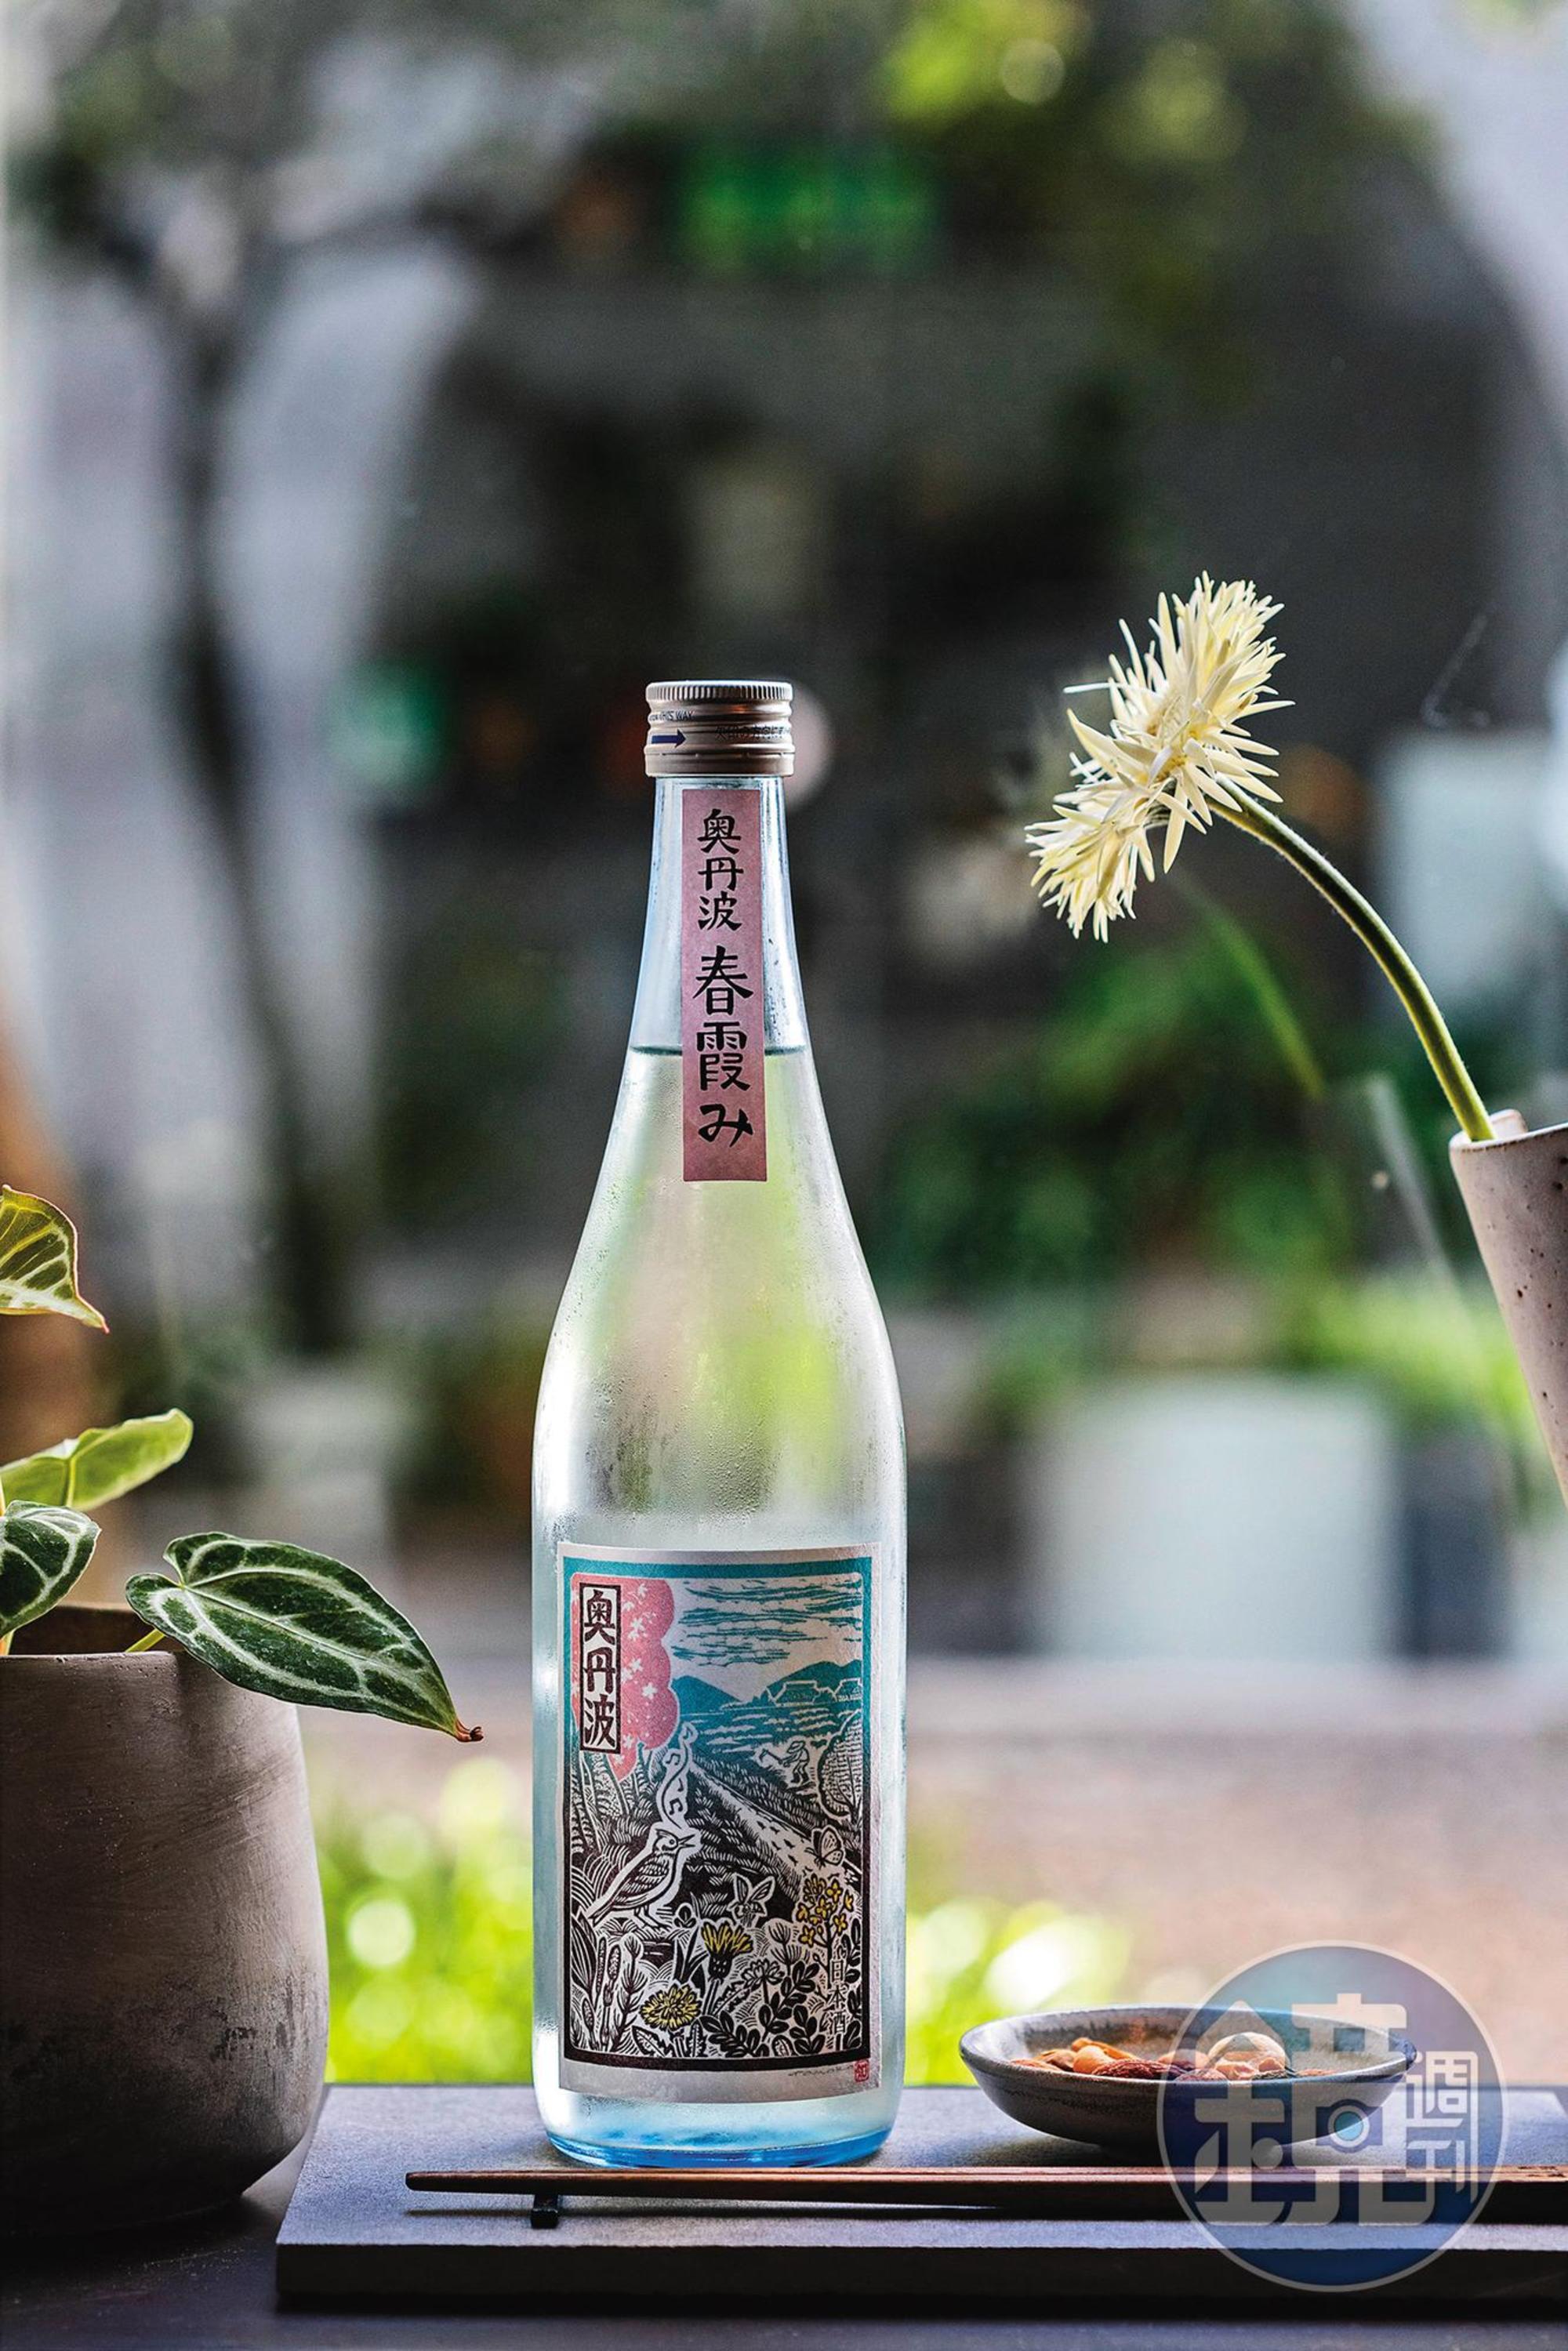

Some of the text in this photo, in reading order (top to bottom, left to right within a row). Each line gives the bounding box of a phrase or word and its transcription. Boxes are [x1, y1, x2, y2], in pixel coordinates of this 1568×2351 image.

[675, 709, 695, 721] WAY
[693, 808, 754, 1148] 奥丹波 春霞み
[584, 1589, 615, 1747] 奥丹波
